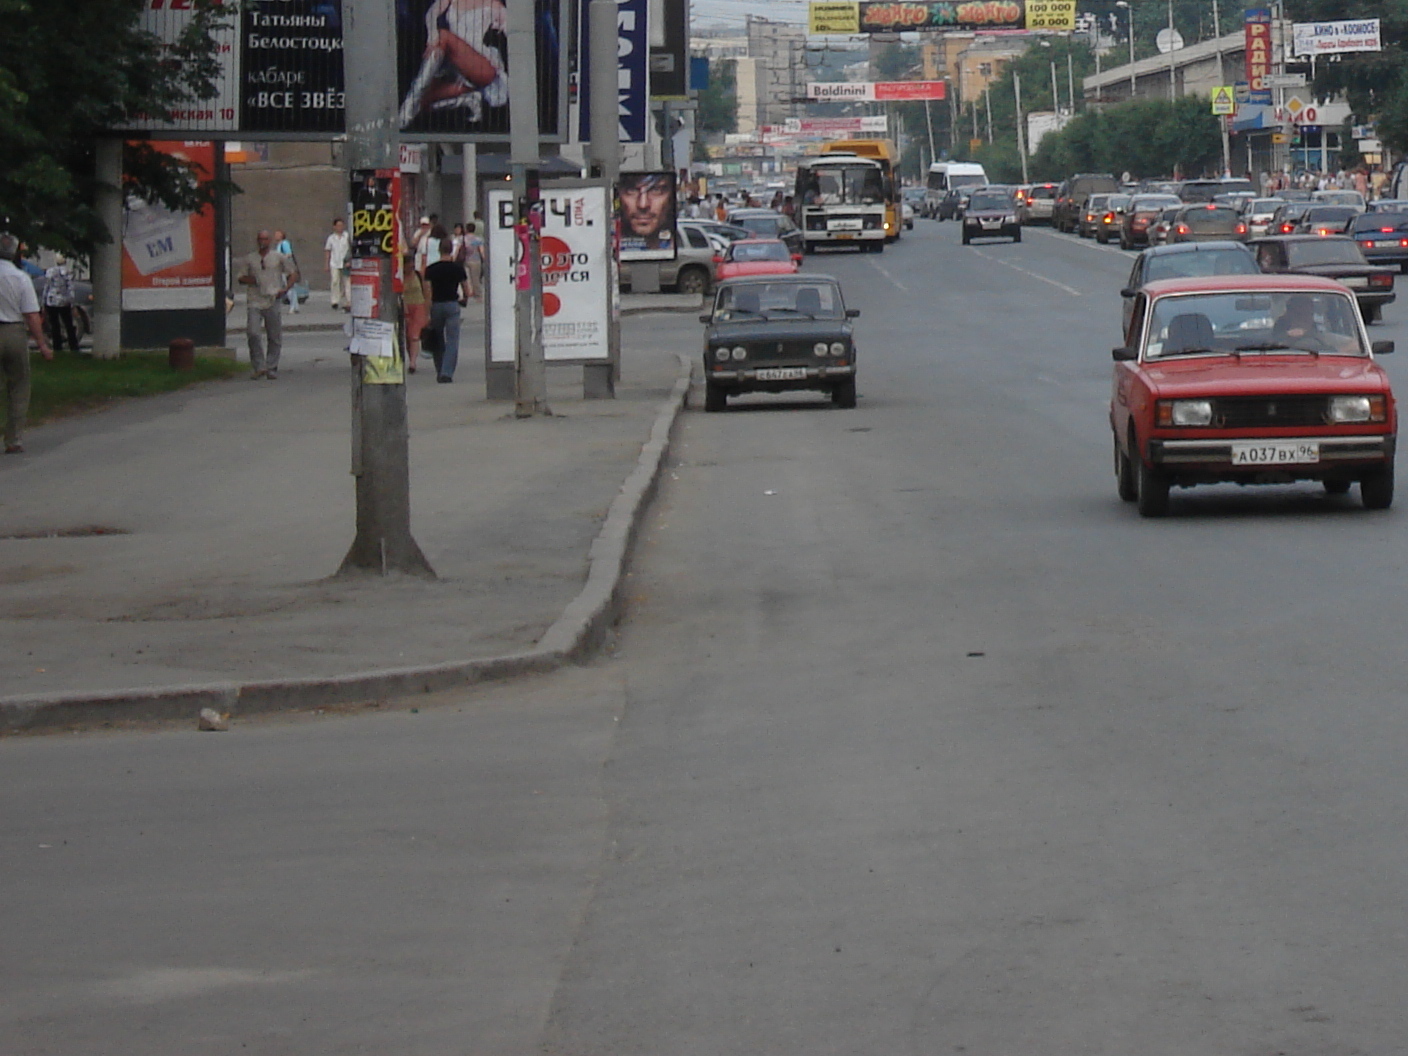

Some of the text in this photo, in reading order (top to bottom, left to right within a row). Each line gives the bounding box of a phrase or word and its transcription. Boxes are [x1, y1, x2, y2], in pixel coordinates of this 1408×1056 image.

[252, 12, 326, 28] Татьяны
[1250, 24, 1266, 90] РАДИО
[814, 85, 866, 96] Baldinini
[220, 109, 235, 121] 10
